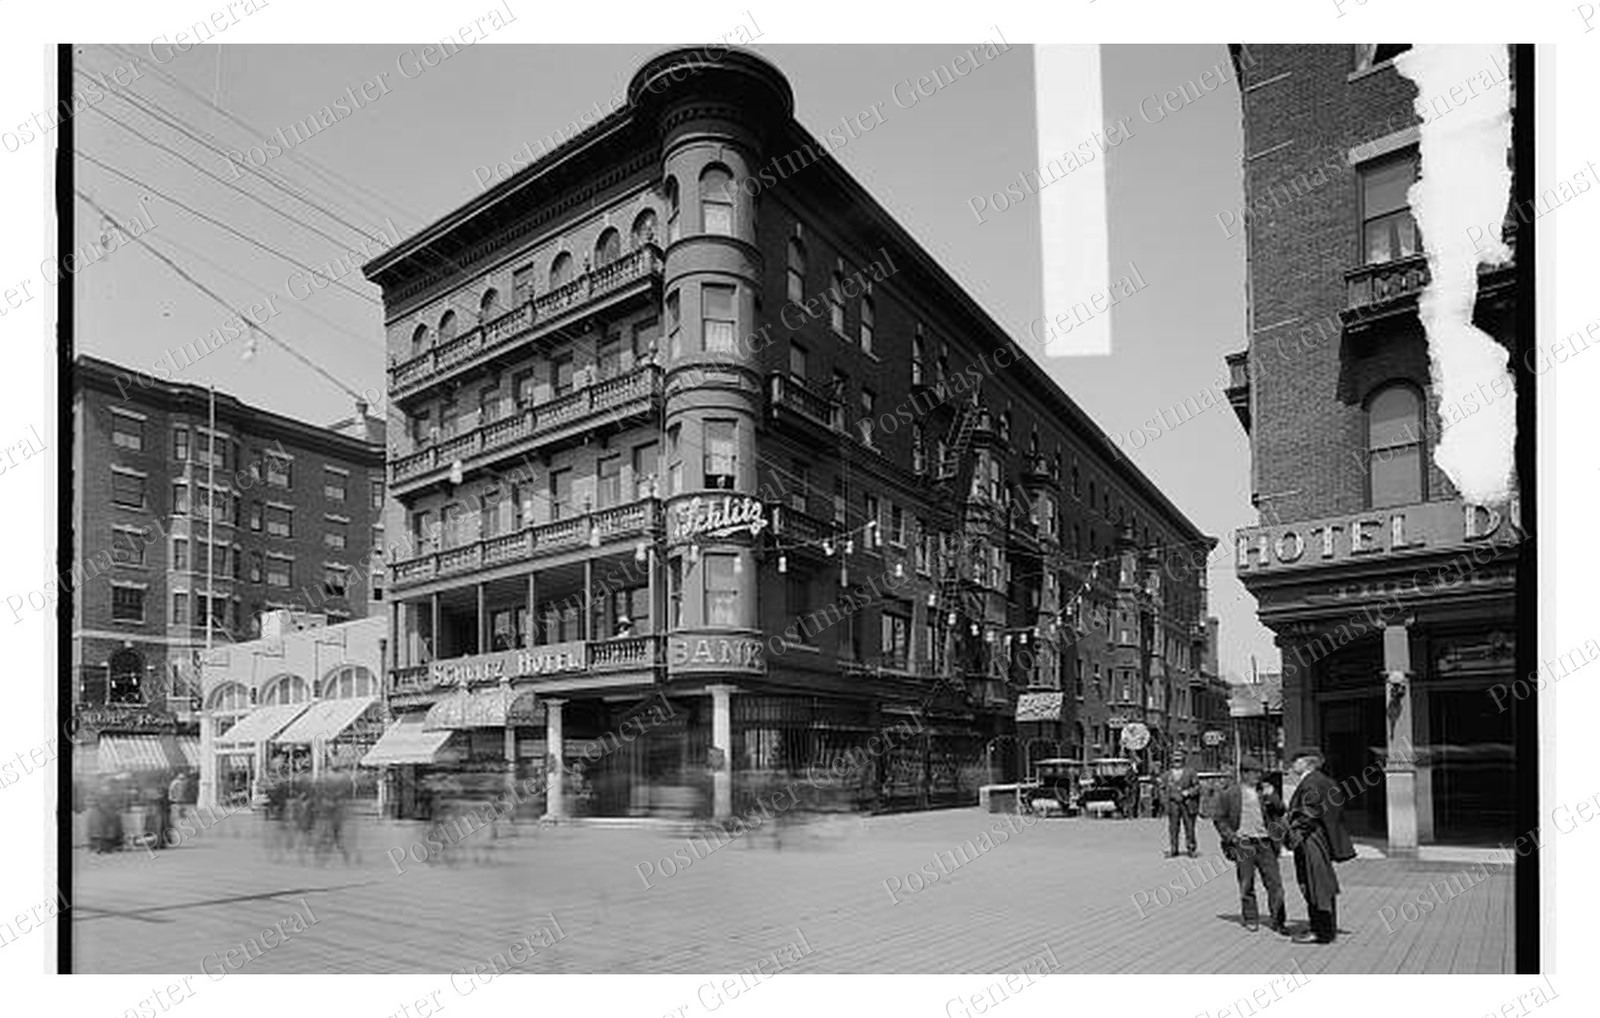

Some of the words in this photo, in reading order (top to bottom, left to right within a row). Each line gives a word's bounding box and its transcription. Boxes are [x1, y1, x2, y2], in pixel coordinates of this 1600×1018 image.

[674, 496, 768, 537] Schlitz
[1237, 513, 1426, 569] HOTEL
[518, 652, 580, 675] HOTEL
[670, 640, 762, 665] BANK
